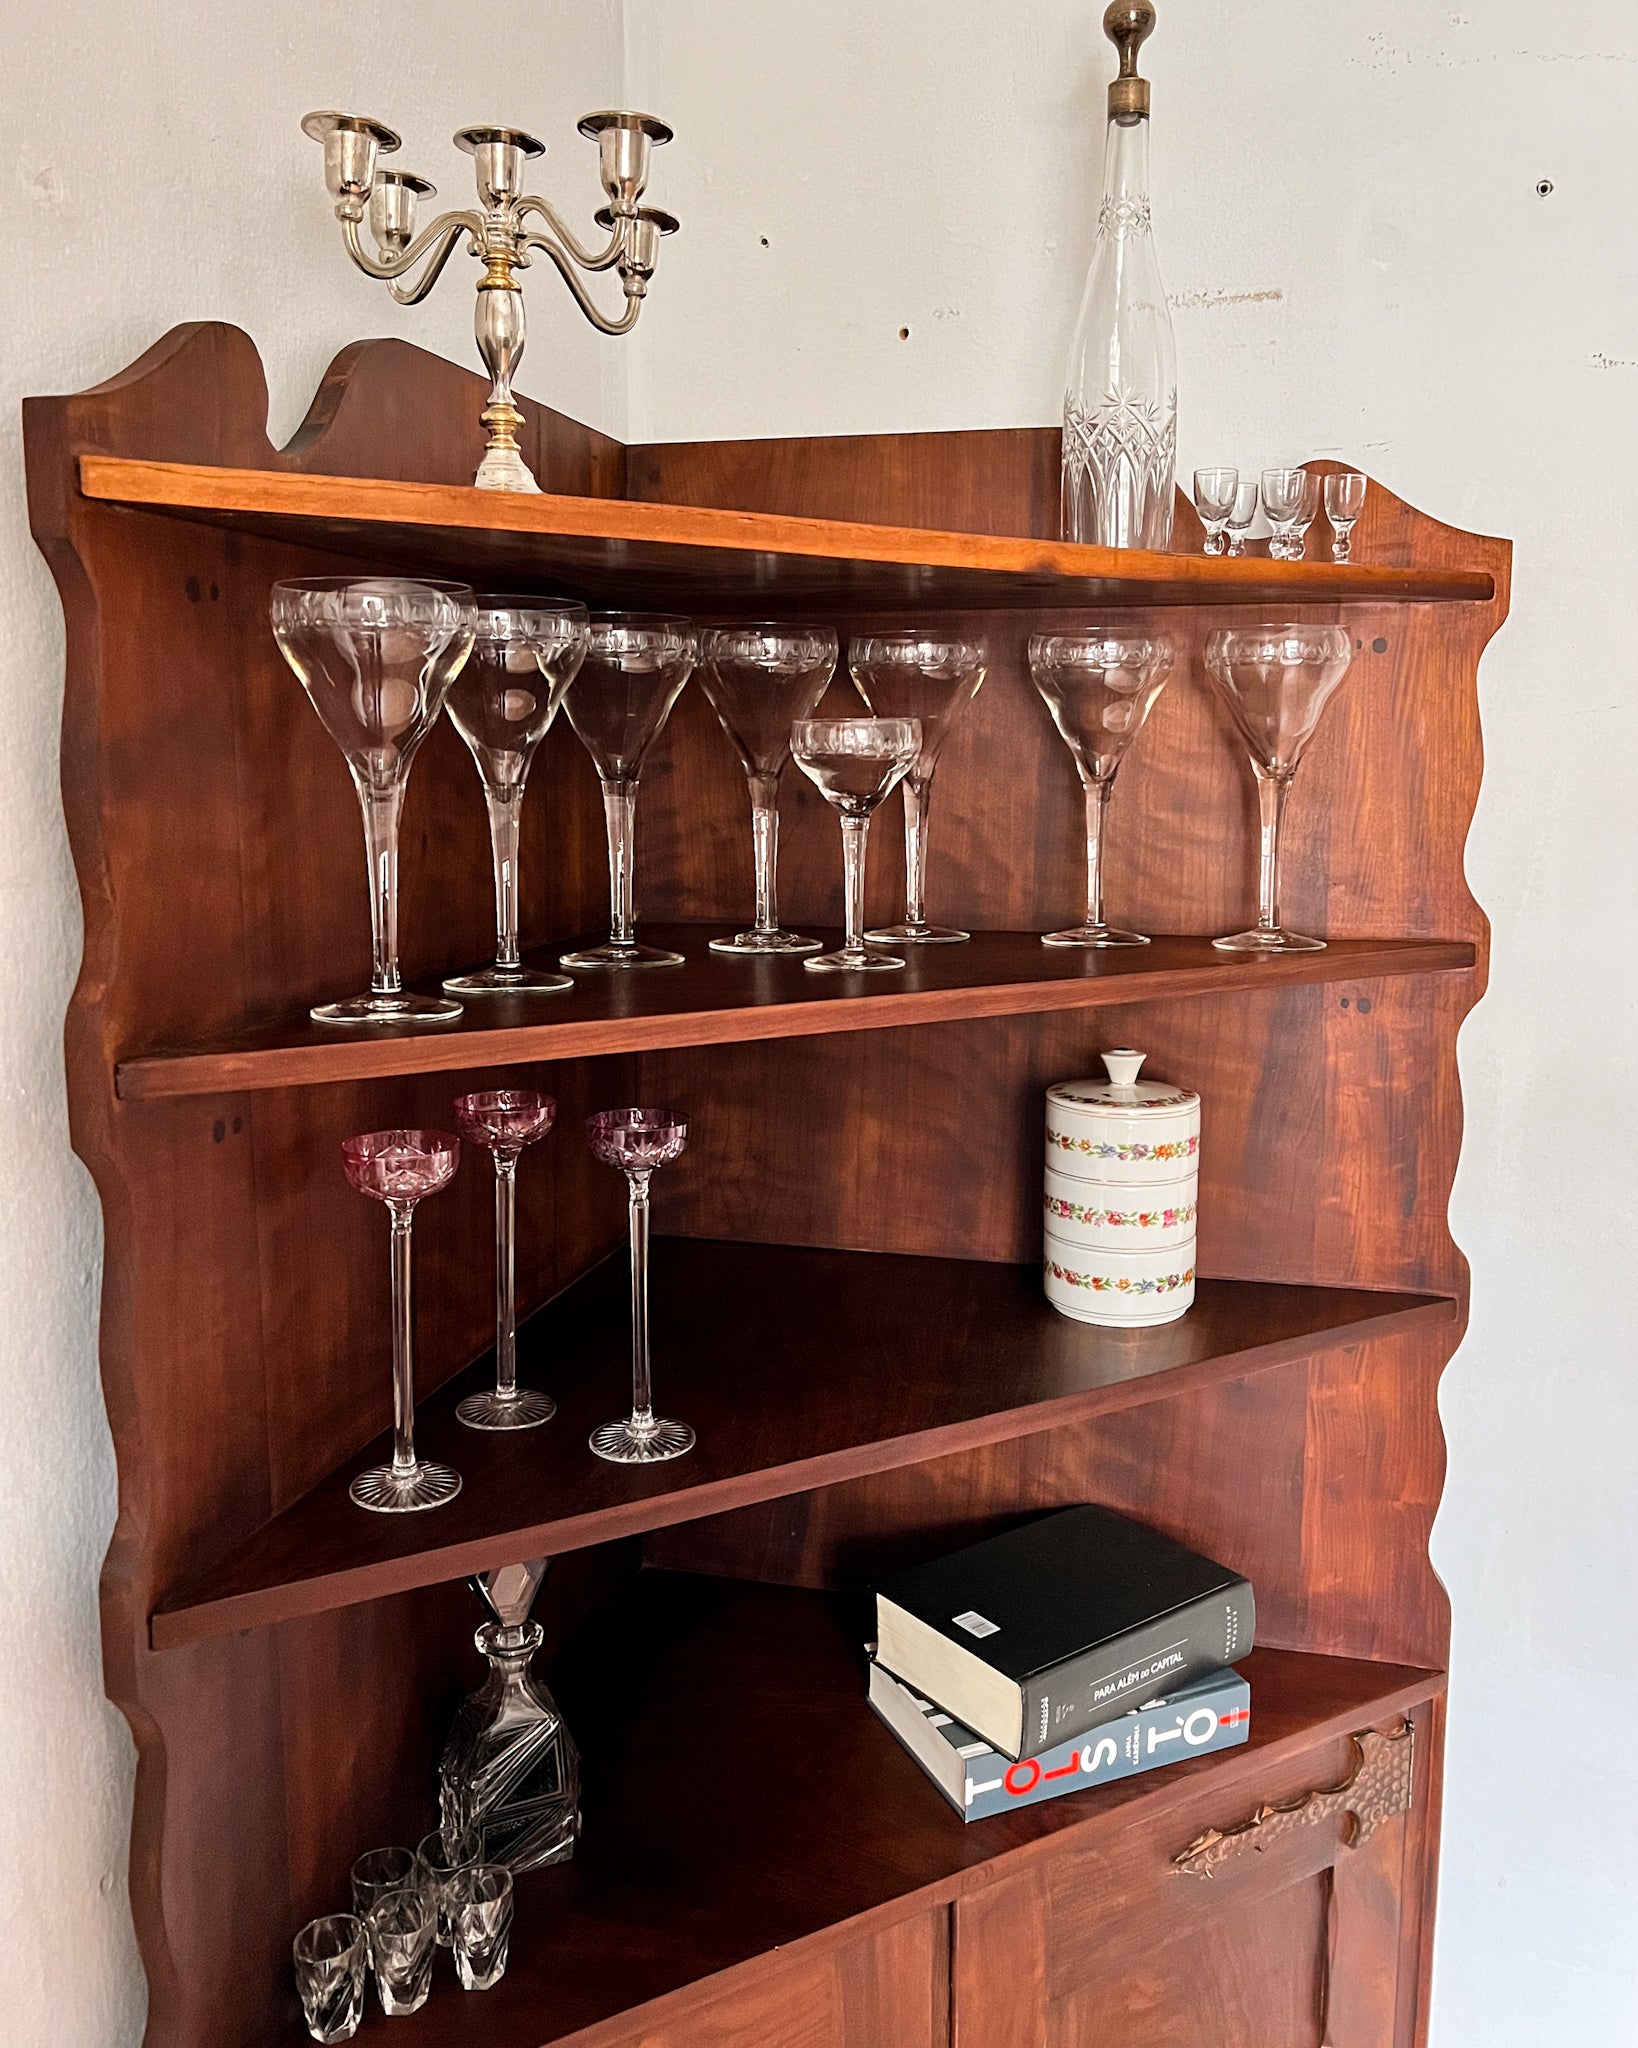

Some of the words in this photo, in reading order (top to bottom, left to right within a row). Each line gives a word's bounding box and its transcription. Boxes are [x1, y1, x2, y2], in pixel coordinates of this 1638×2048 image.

[1094, 1682, 1117, 1701] PARA
[1116, 1671, 1140, 1690] ALÉM
[1150, 1651, 1184, 1674] CAPITAL
